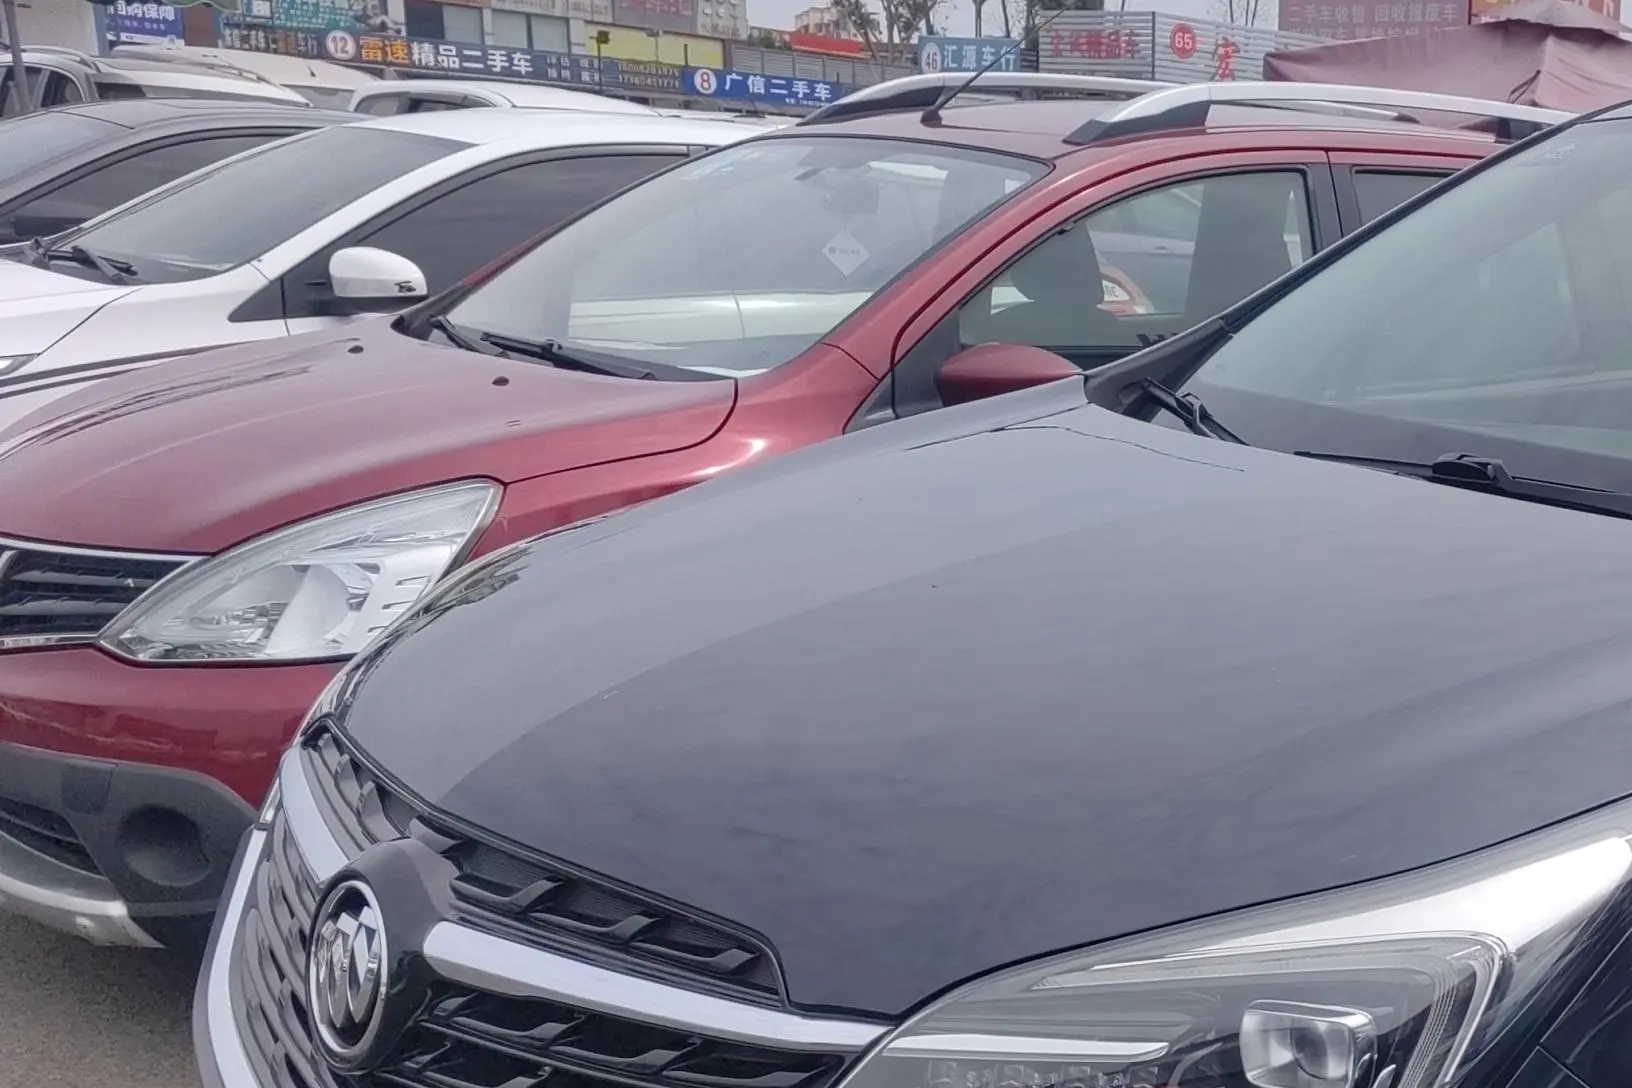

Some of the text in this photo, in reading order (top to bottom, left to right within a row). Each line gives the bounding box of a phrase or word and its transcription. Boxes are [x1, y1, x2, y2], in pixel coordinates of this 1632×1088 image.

[331, 35, 350, 58] 12
[1174, 32, 1193, 50] 65
[924, 53, 938, 71] 46
[944, 44, 1016, 71] 汇源车行
[701, 71, 712, 92] 8
[725, 73, 832, 101] 广信二手车
